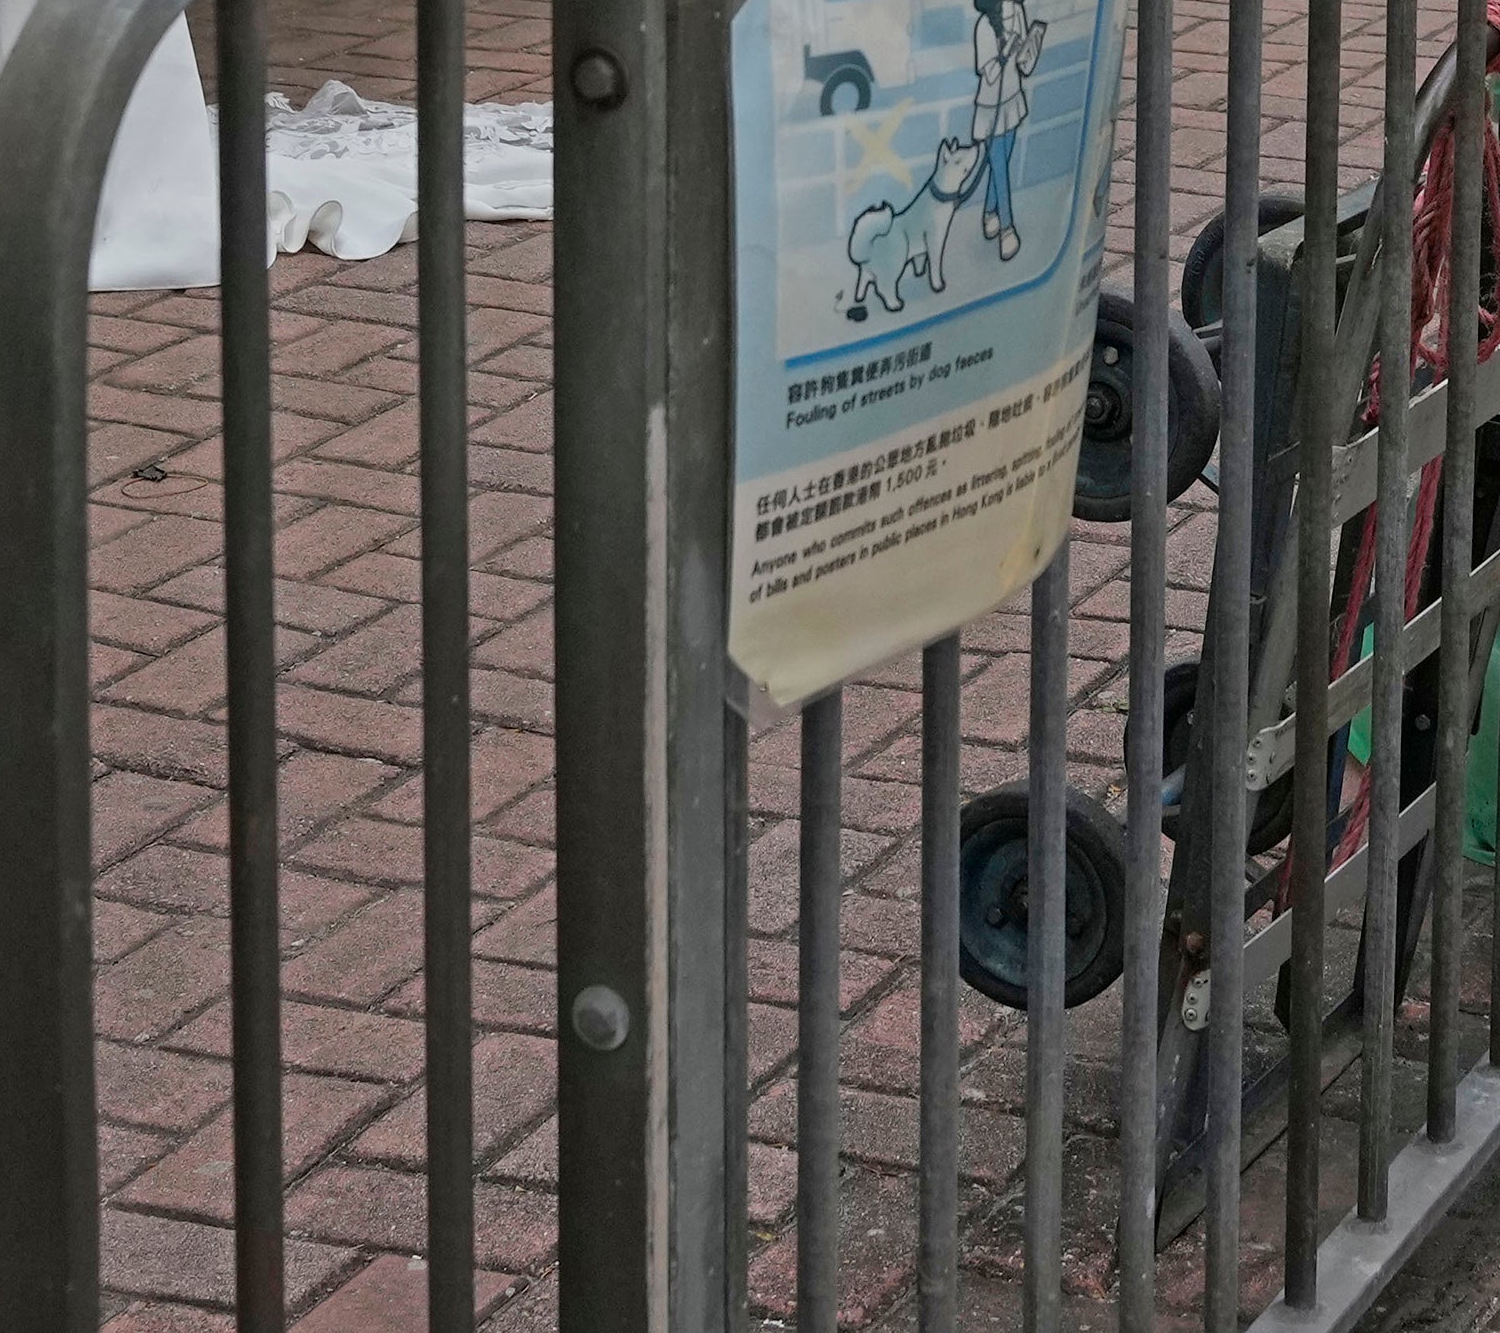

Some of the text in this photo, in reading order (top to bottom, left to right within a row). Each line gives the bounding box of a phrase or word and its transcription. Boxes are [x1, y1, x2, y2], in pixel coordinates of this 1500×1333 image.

[786, 403, 837, 429] Fouling
[842, 393, 856, 414] of
[861, 380, 905, 408] streets
[910, 372, 925, 391] by
[929, 362, 951, 382] dog
[886, 465, 923, 493] 1,500
[749, 584, 763, 604] of
[766, 577, 788, 598] bills
[791, 565, 813, 589] and
[871, 532, 902, 557] public
[952, 501, 978, 521] Hong
[981, 488, 1004, 508] Kong
[751, 551, 797, 577] Anyone
[803, 539, 826, 558] who
[880, 506, 904, 529] such
